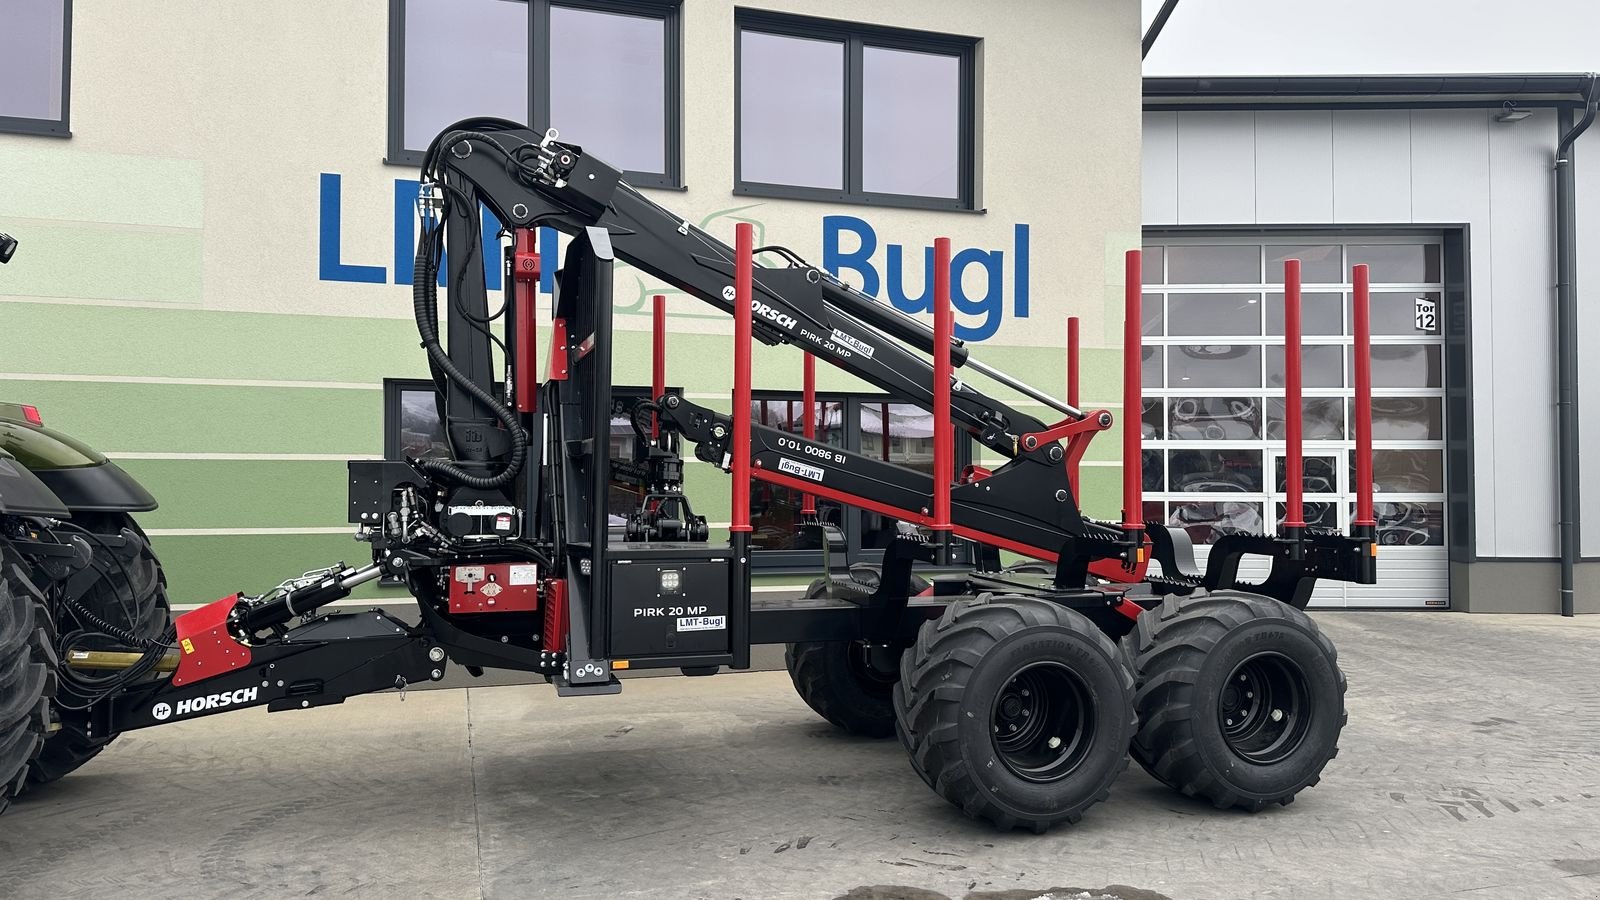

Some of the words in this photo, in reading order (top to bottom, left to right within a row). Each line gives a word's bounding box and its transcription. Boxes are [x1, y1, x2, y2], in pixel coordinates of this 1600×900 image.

[822, 214, 1030, 343] Bugl
[1416, 303, 1435, 312] Tor
[1416, 313, 1435, 328] 12
[751, 299, 798, 331] ORSCH
[800, 328, 822, 345] PIRK
[823, 340, 836, 351] 20
[836, 346, 852, 358] MP
[777, 437, 801, 451] 10.0
[804, 445, 832, 460] 9800
[834, 453, 847, 465] IB
[781, 462, 821, 480] LMT-Bugl
[633, 606, 665, 617] PIRK
[668, 606, 684, 616] 20
[687, 605, 708, 616] MP
[679, 616, 723, 627] LMT-Bugl
[175, 686, 258, 715] HORSCH
